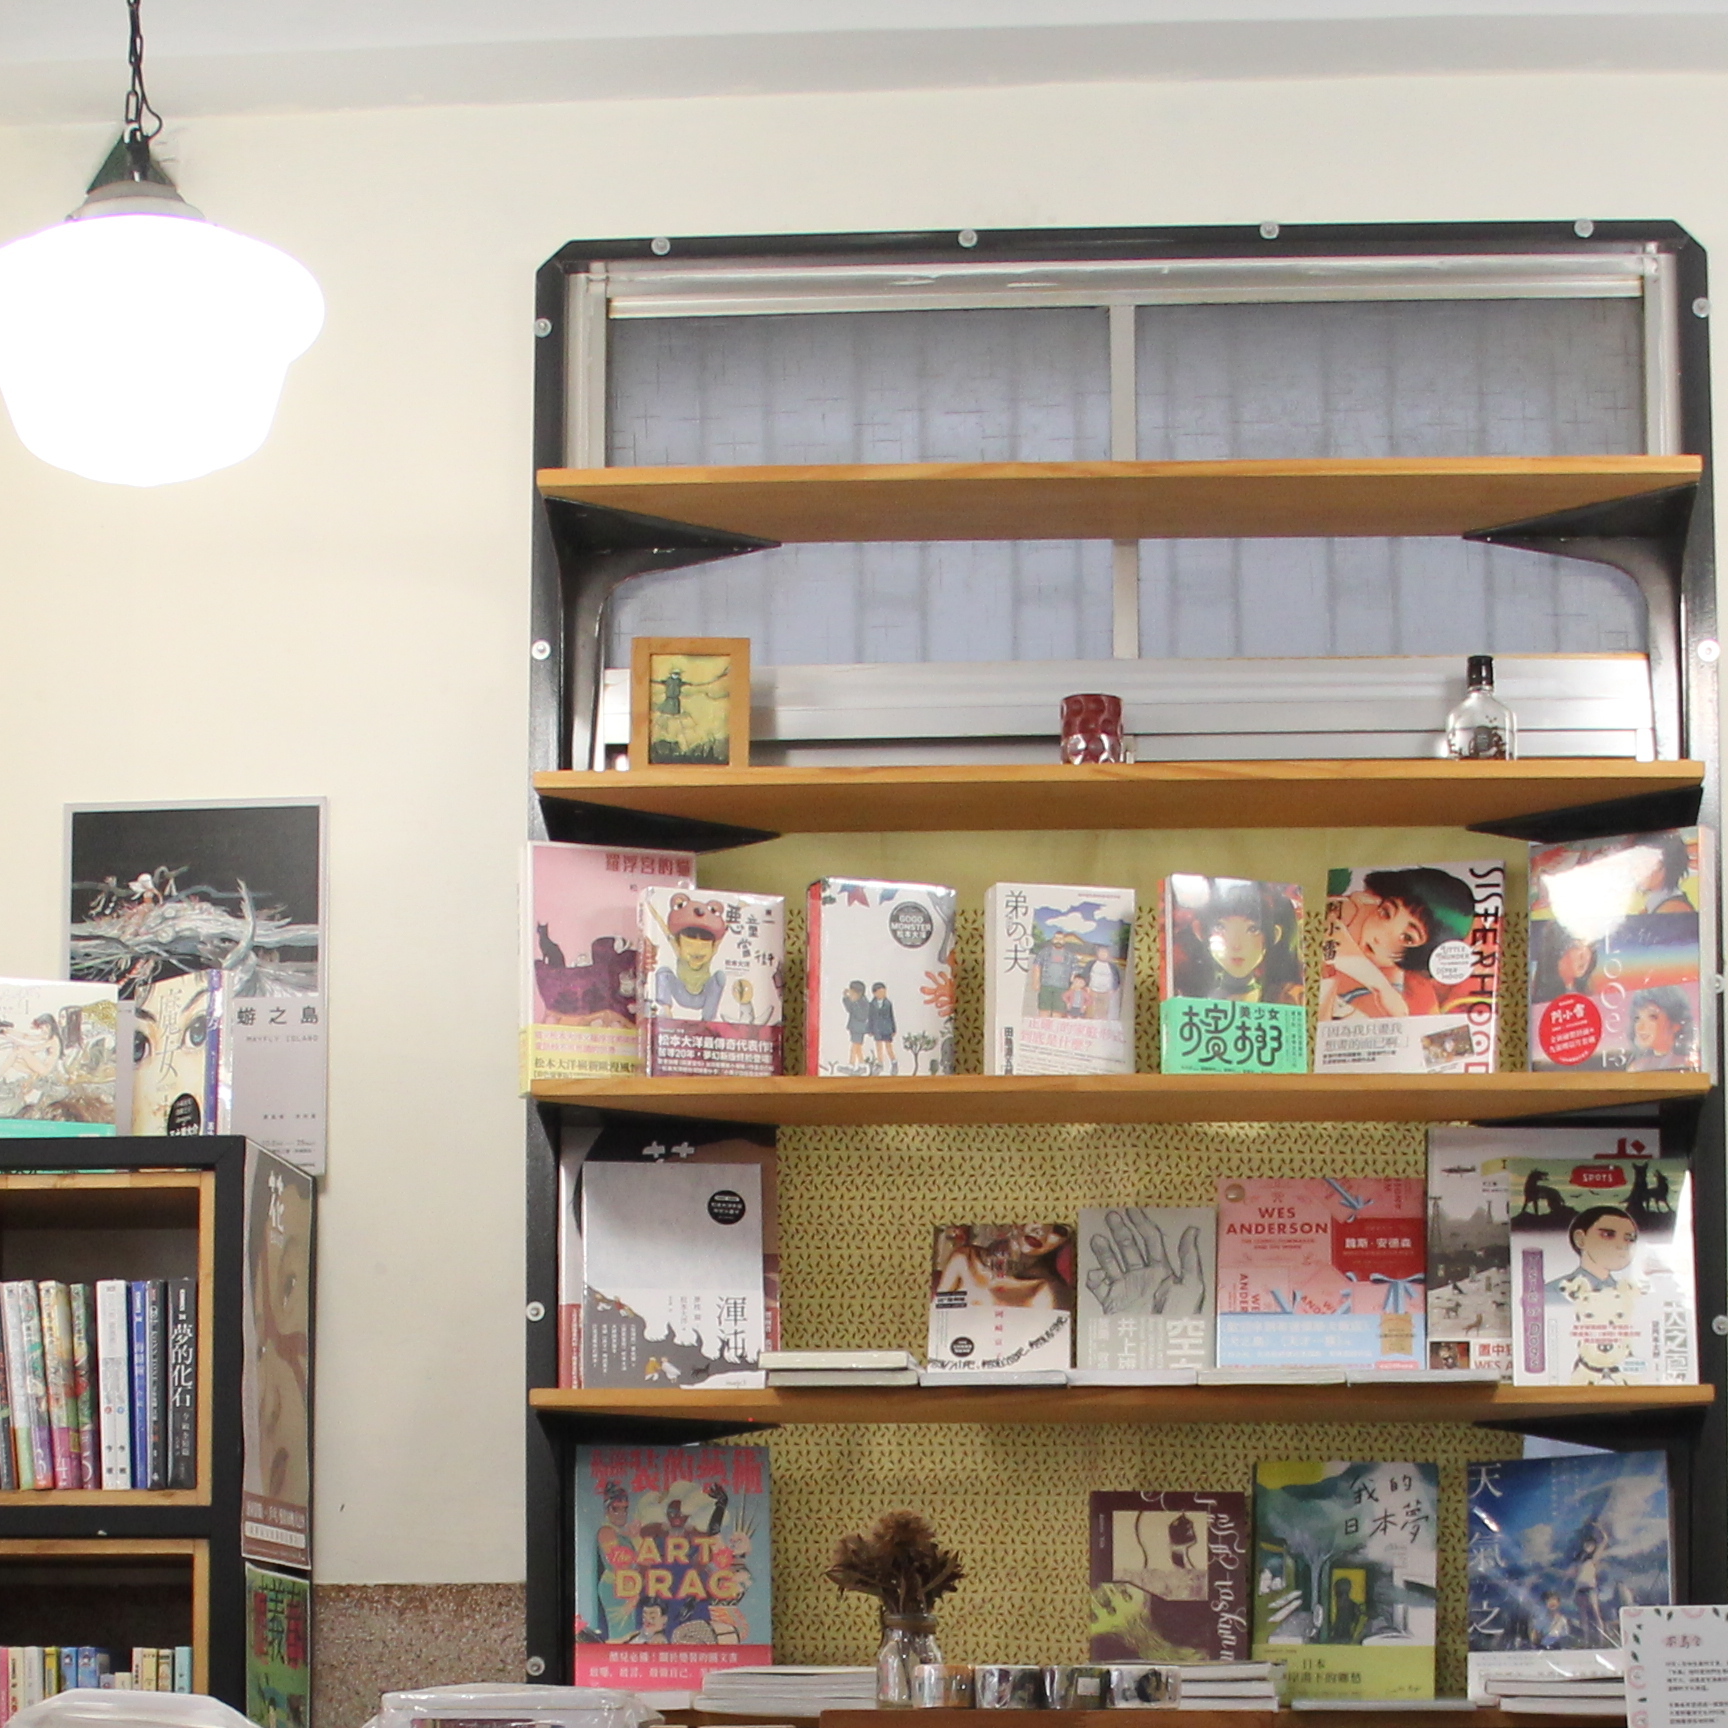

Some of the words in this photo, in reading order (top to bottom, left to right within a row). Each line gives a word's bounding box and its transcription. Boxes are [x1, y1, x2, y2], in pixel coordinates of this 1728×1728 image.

[1004, 890, 1029, 974] 弟の夫
[1258, 1206, 1296, 1219] WES
[1226, 1222, 1328, 1235] ANDERSON
[172, 1325, 193, 1407] 夢的化石
[1352, 1473, 1413, 1505] 我的
[1343, 1499, 1429, 1544] 日本夢
[636, 1536, 717, 1565] ART
[614, 1569, 739, 1600] DRAG
